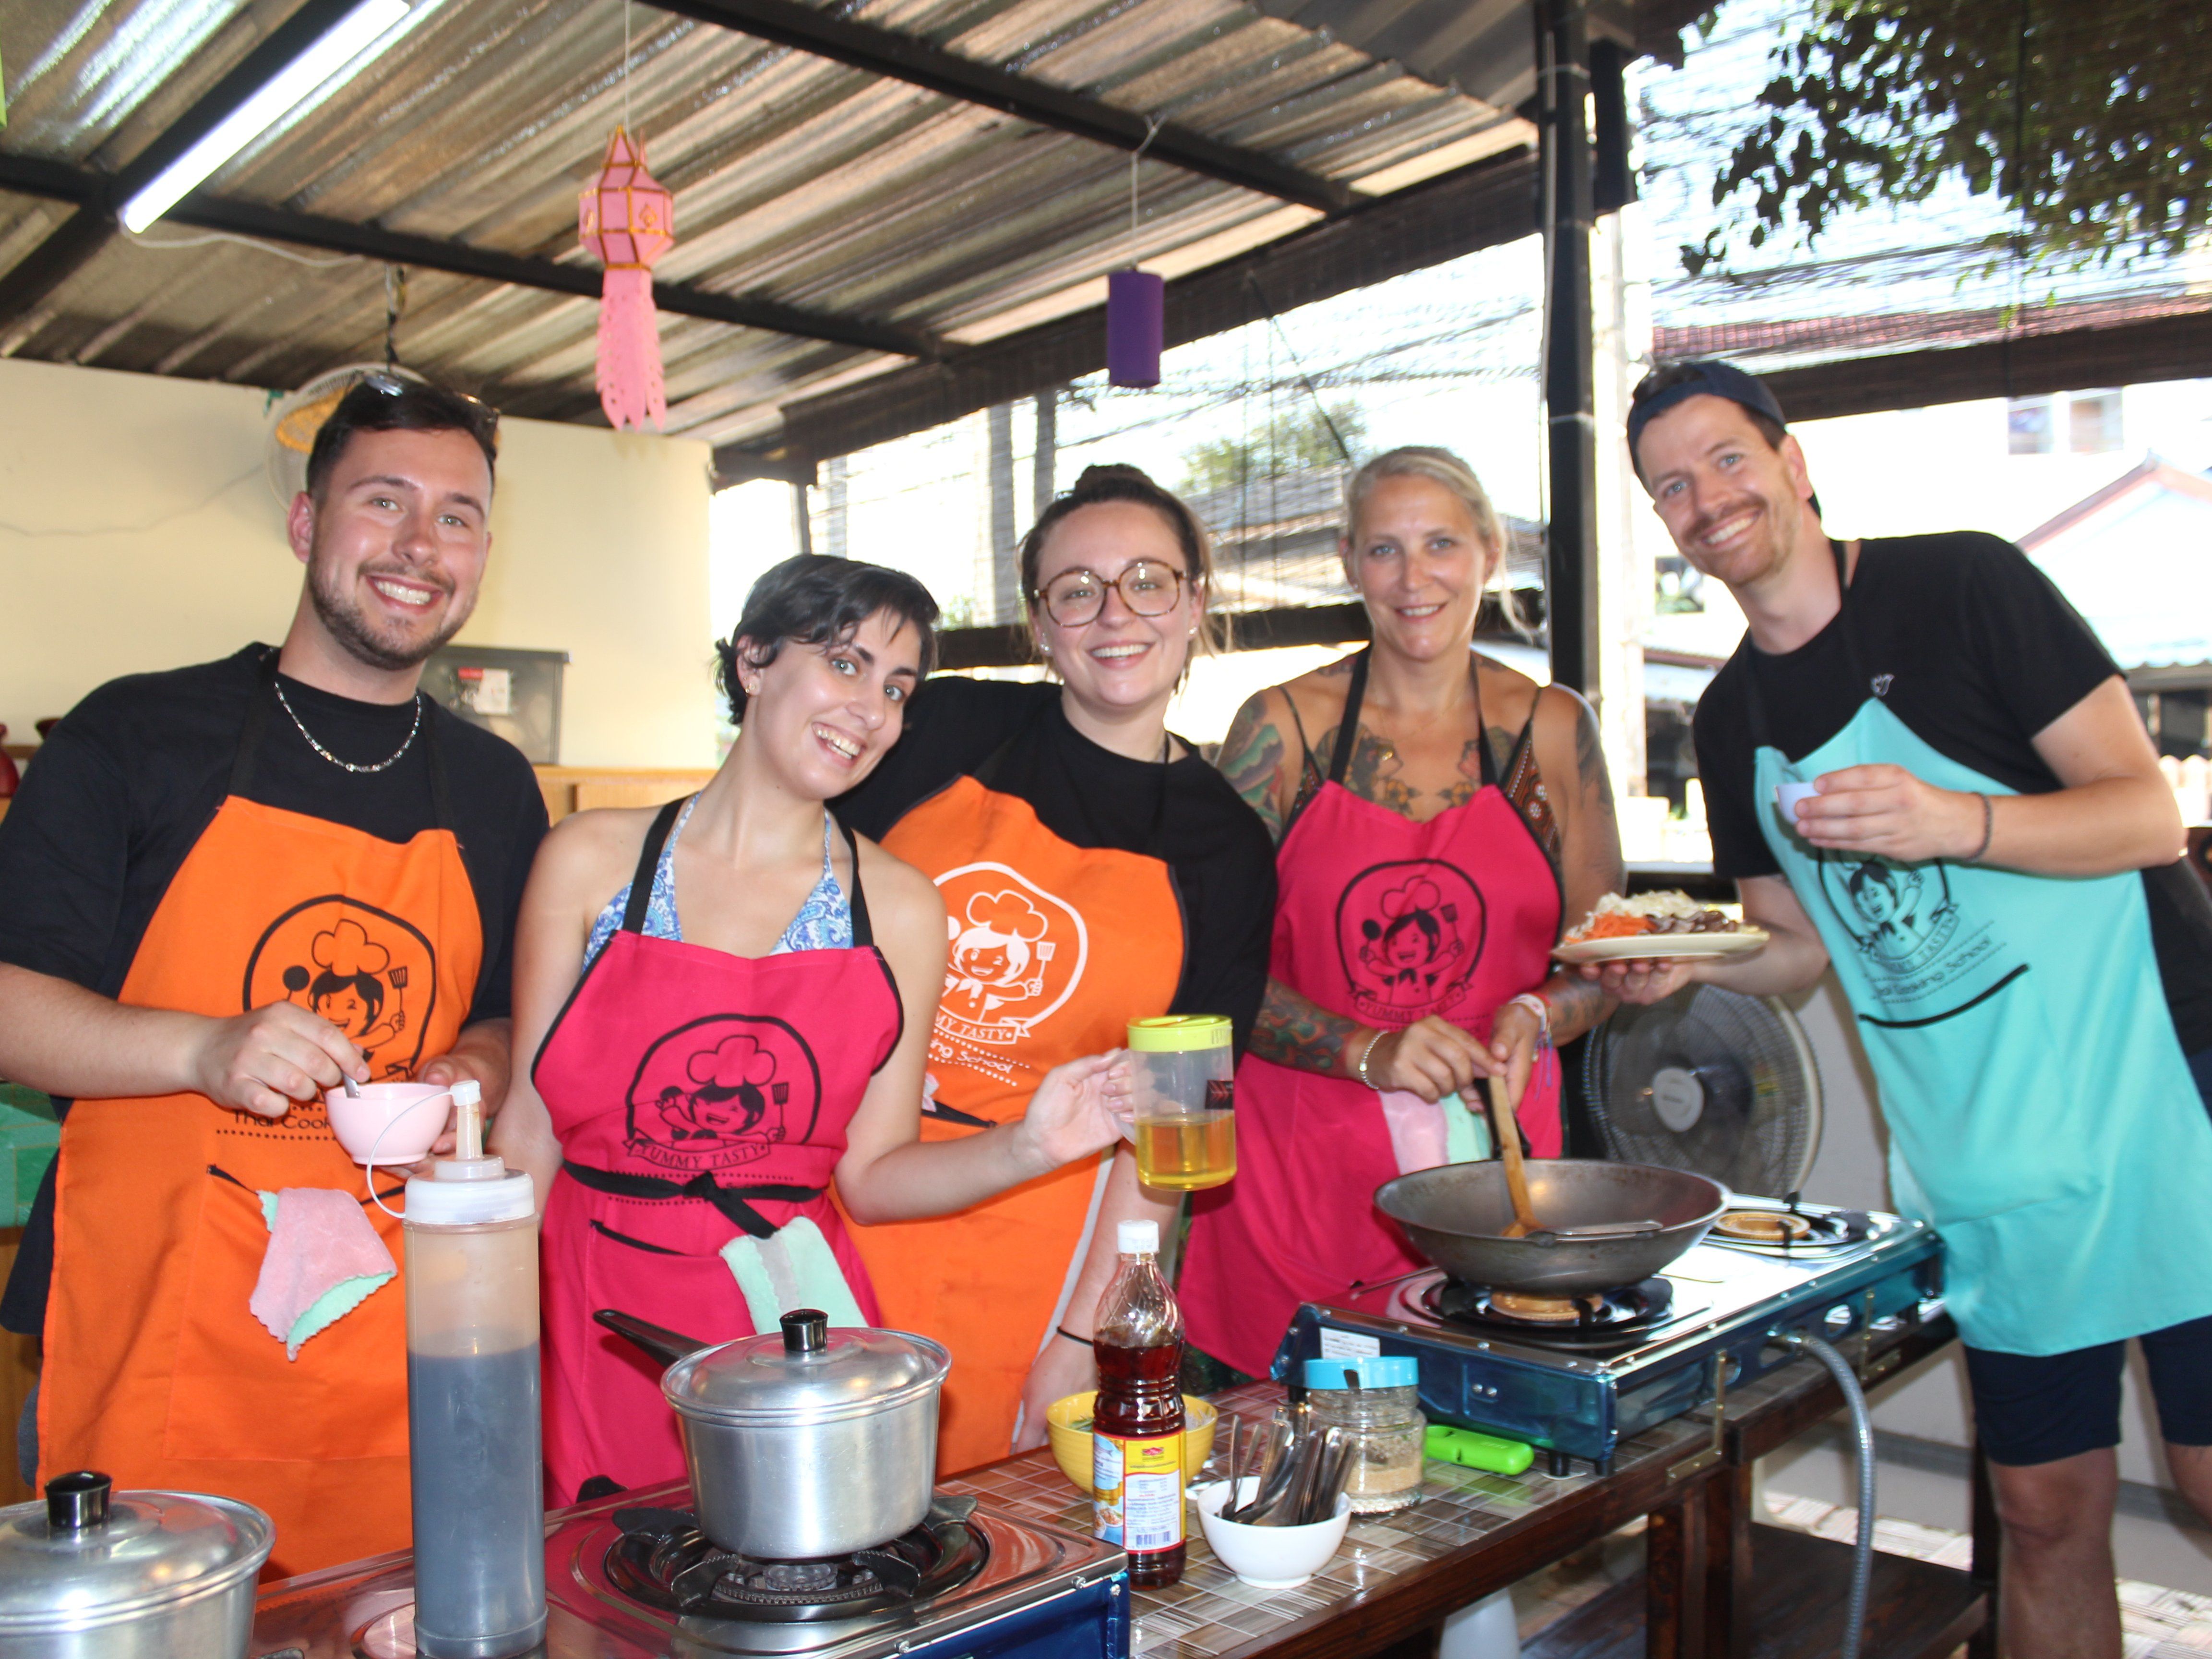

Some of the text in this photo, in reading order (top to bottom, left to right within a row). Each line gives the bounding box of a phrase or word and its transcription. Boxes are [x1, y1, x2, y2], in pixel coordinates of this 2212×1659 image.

[960, 1023, 1007, 1040] TASTY
[957, 1050, 1014, 1074] School
[233, 1109, 330, 1129] Thai Cook
[641, 1145, 758, 1168] YUMMY TASTY
